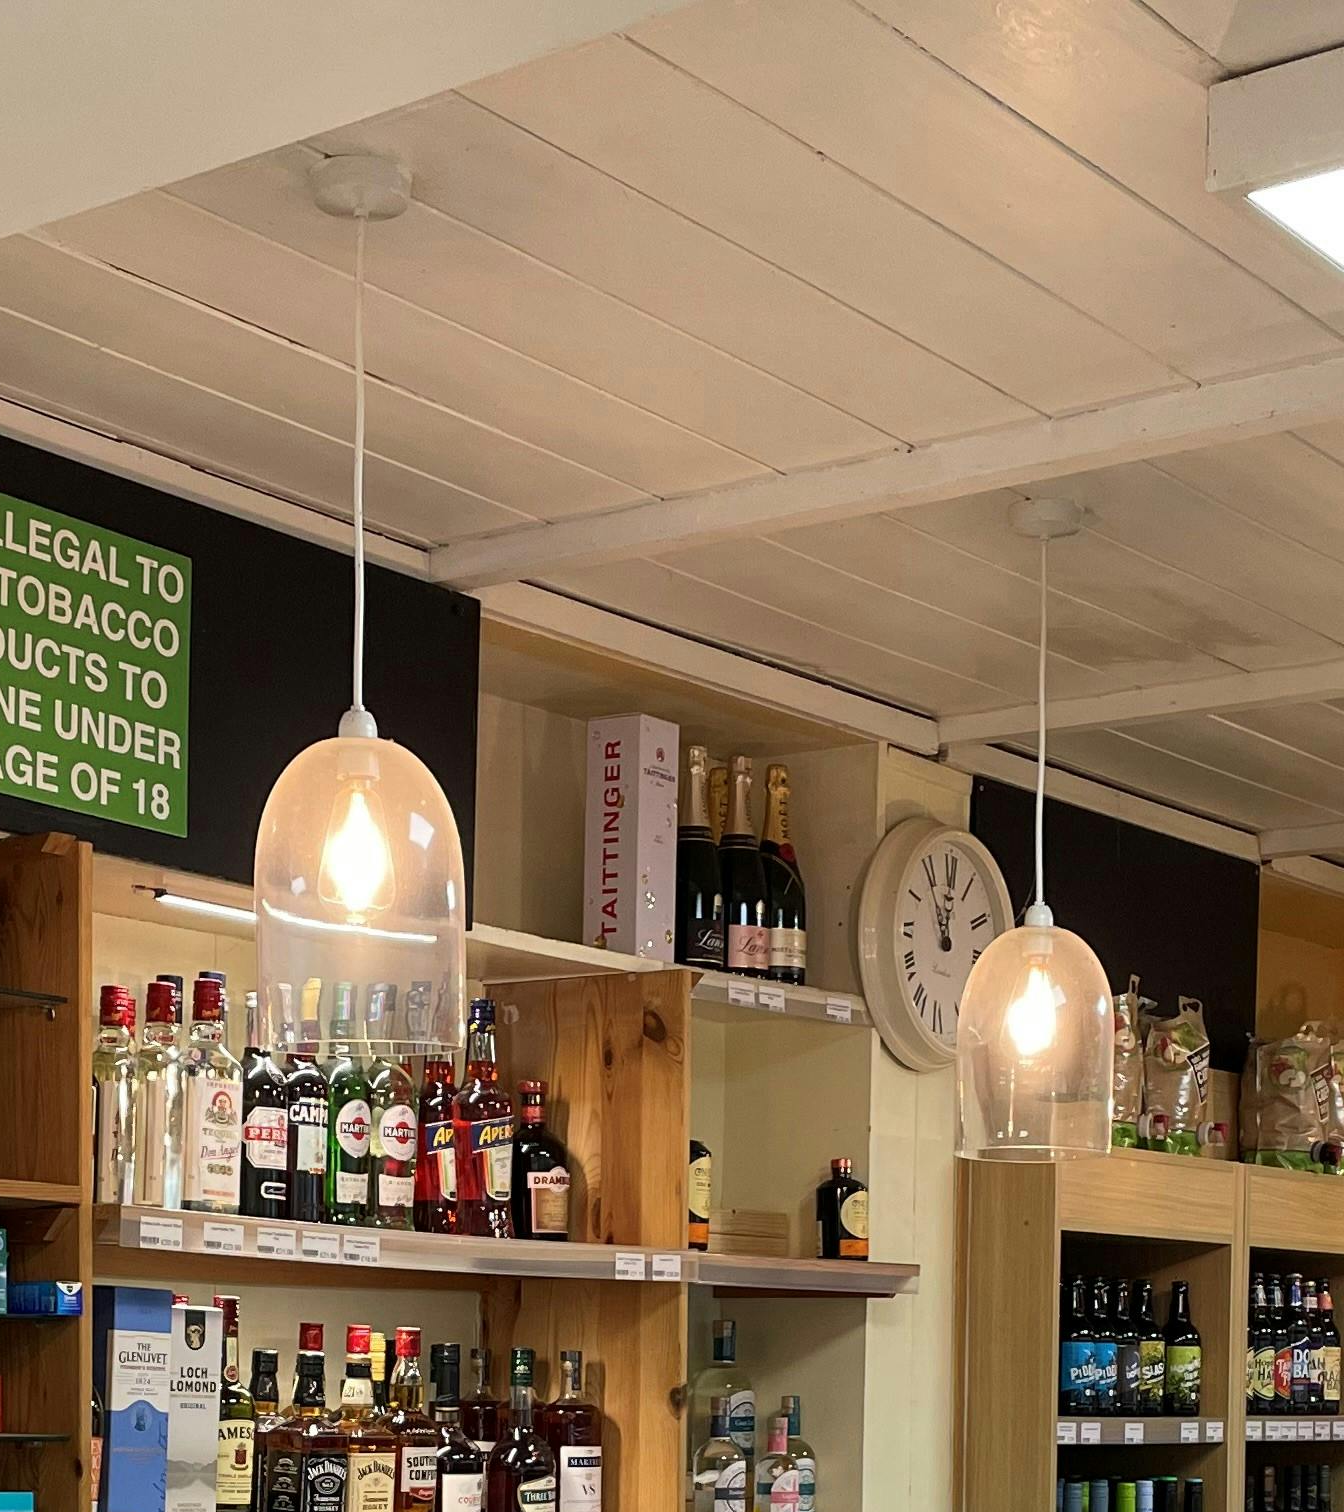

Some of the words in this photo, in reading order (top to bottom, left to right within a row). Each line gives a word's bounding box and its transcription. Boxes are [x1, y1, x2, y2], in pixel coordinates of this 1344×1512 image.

[135, 554, 185, 605] TO
[118, 660, 168, 710] TO
[54, 699, 182, 770] UNDER
[70, 760, 122, 806] OF
[131, 777, 171, 821] 18
[600, 739, 622, 939] TAITTINGER
[118, 1350, 168, 1366] GLENLIVET
[136, 1342, 152, 1352] THE
[169, 1379, 217, 1394] LOMOND
[179, 1366, 209, 1380] LOCH
